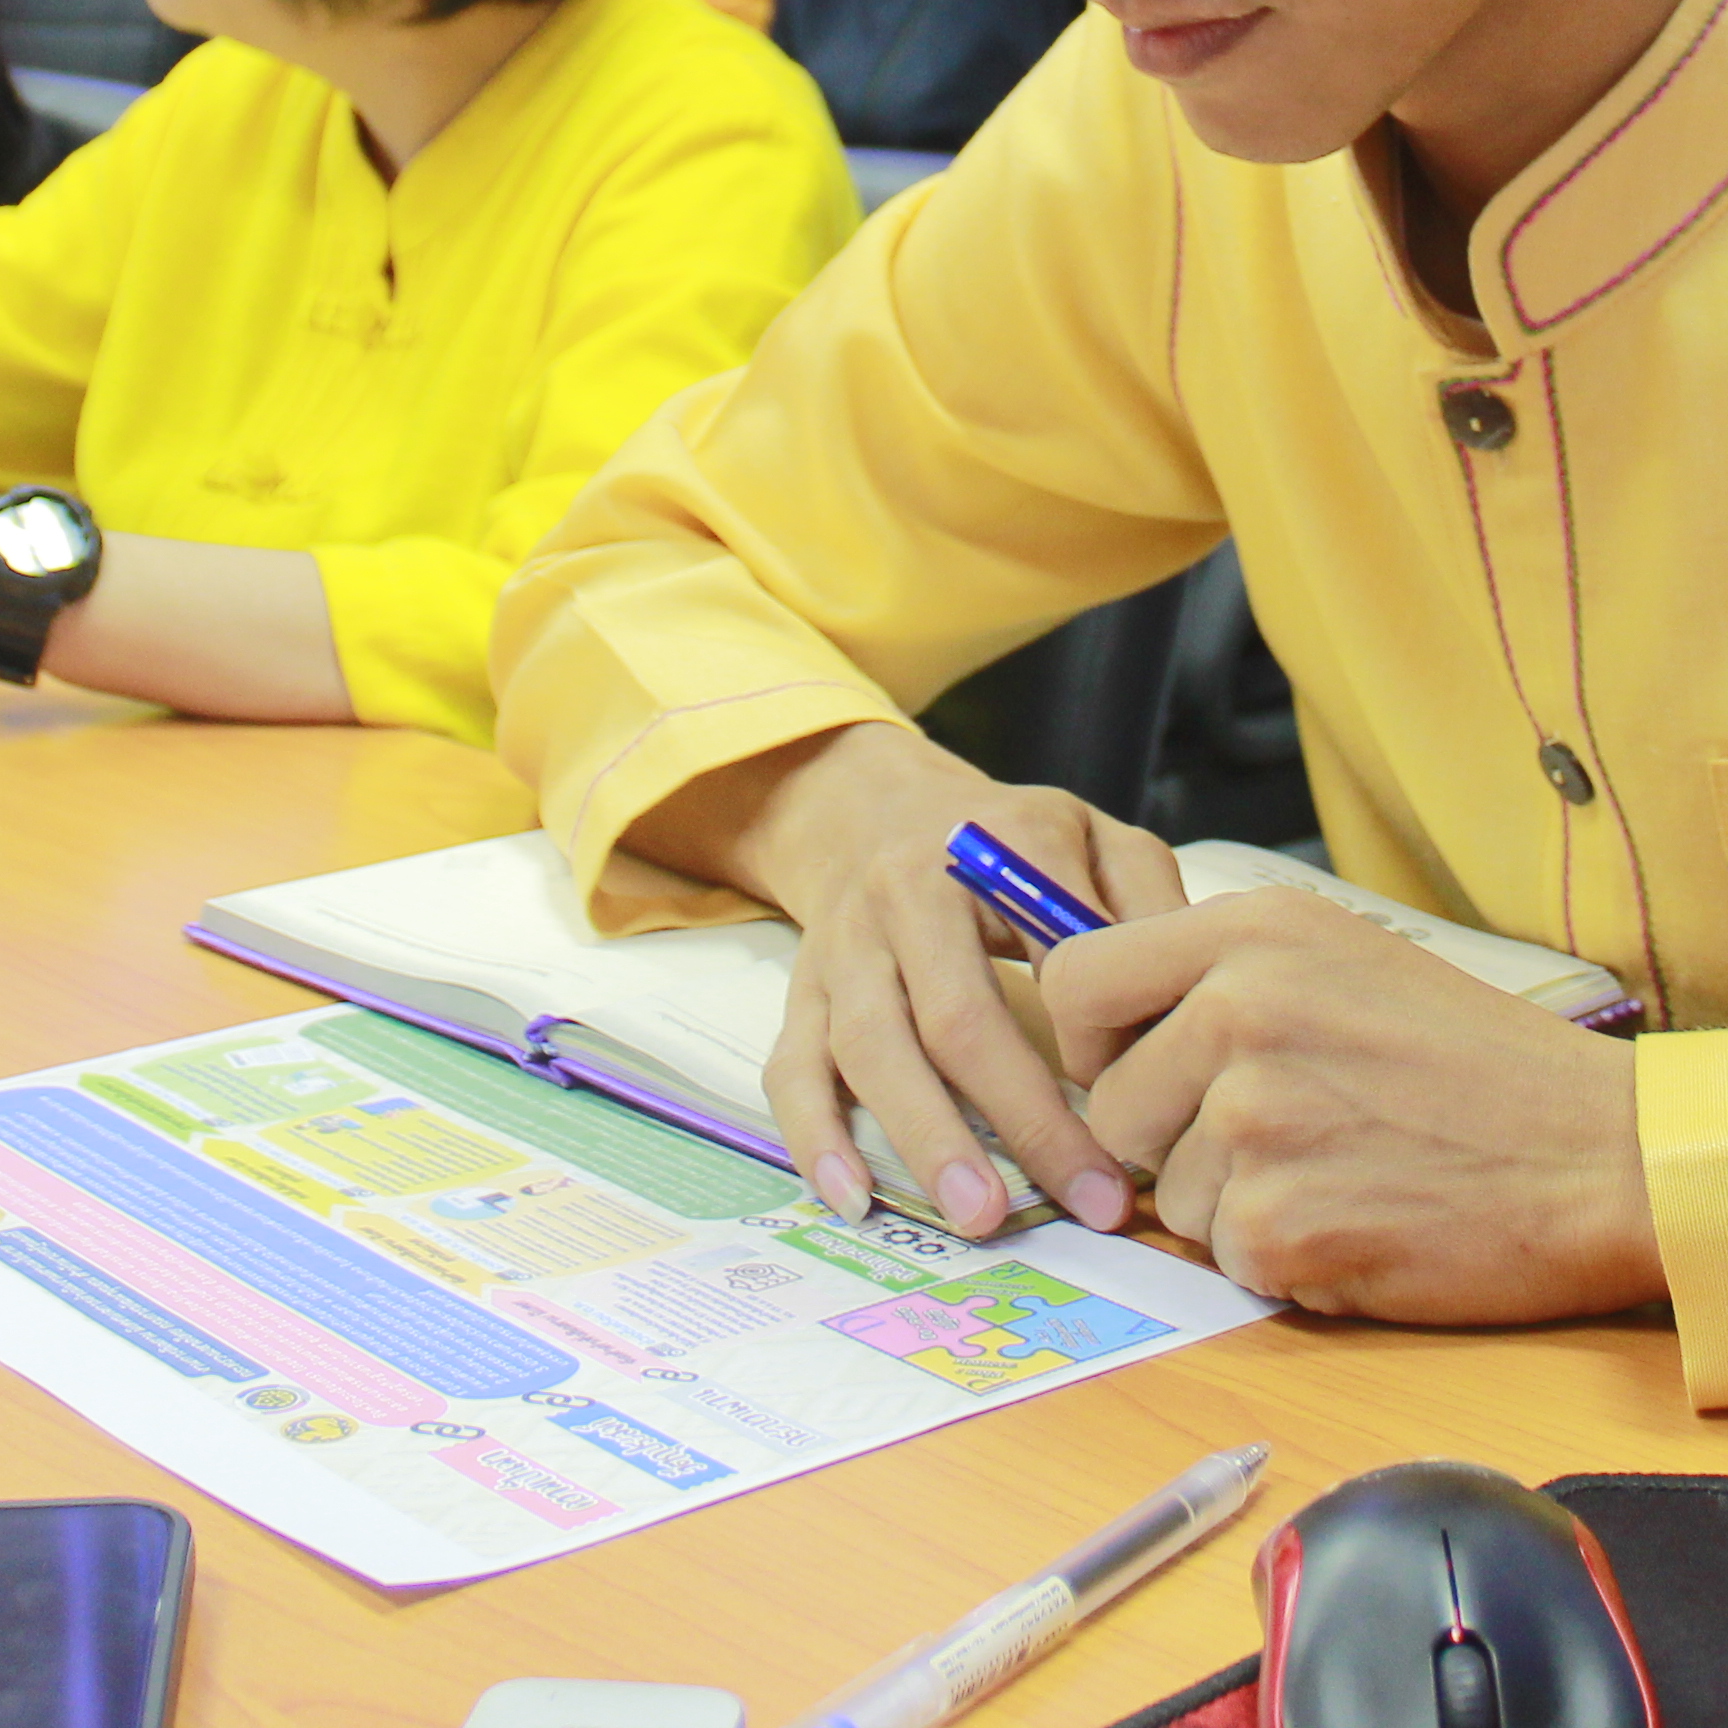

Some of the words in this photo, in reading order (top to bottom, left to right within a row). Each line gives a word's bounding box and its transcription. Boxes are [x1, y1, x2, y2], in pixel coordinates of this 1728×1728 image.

[582, 1413, 719, 1480] วัตถุประสงค์
[478, 1448, 600, 1513] ความเป็นมา
